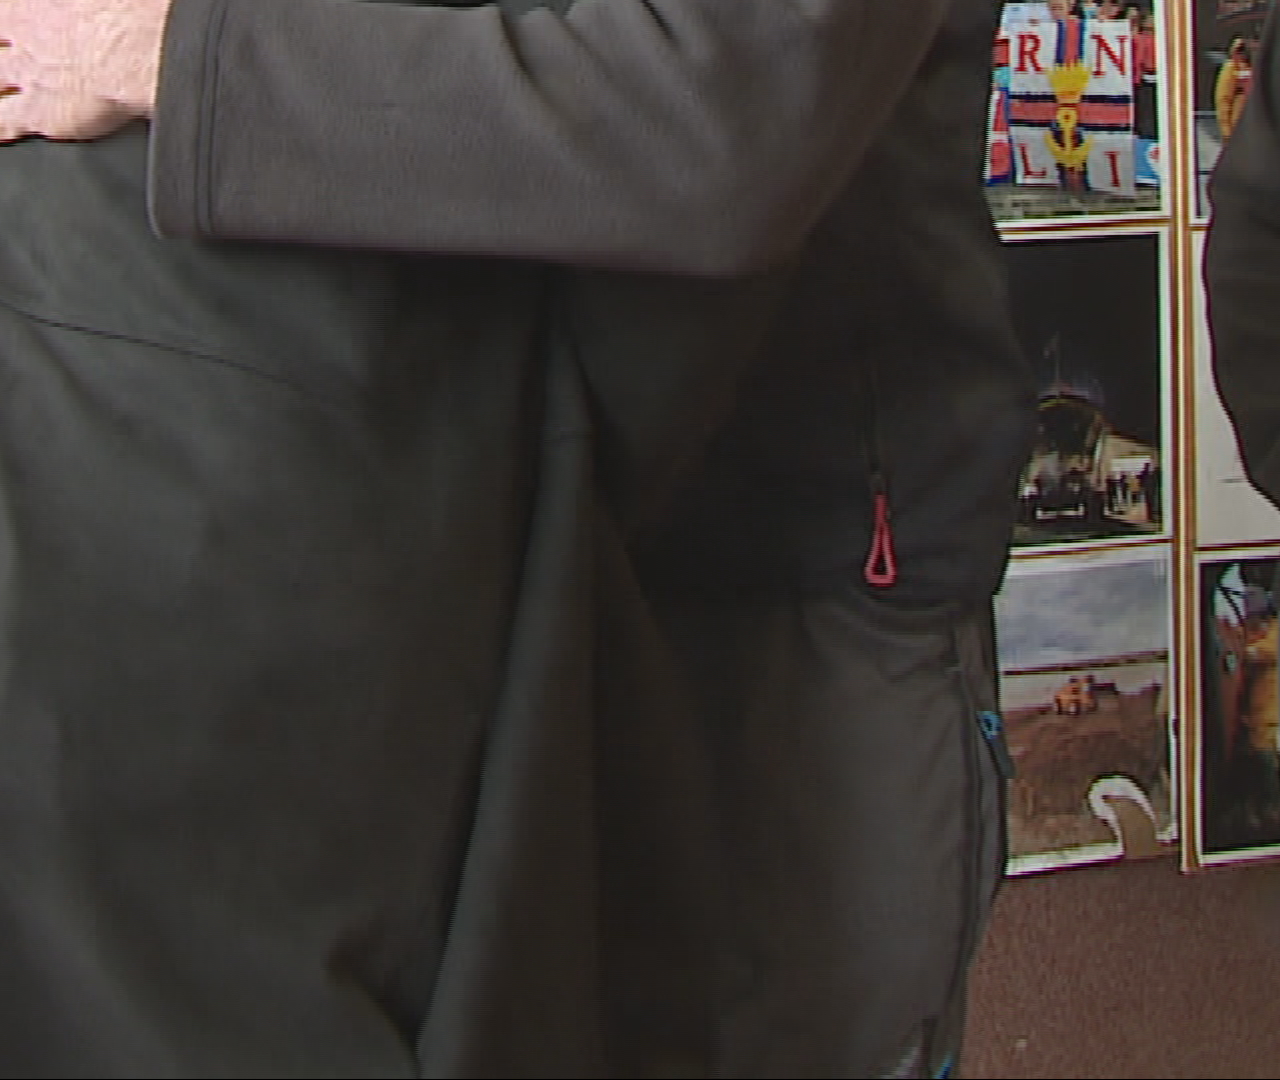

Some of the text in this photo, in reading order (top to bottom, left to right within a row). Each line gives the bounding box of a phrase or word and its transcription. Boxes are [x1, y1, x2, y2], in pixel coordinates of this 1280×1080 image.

[1015, 31, 1129, 77] R N
[1018, 142, 1048, 178] L
